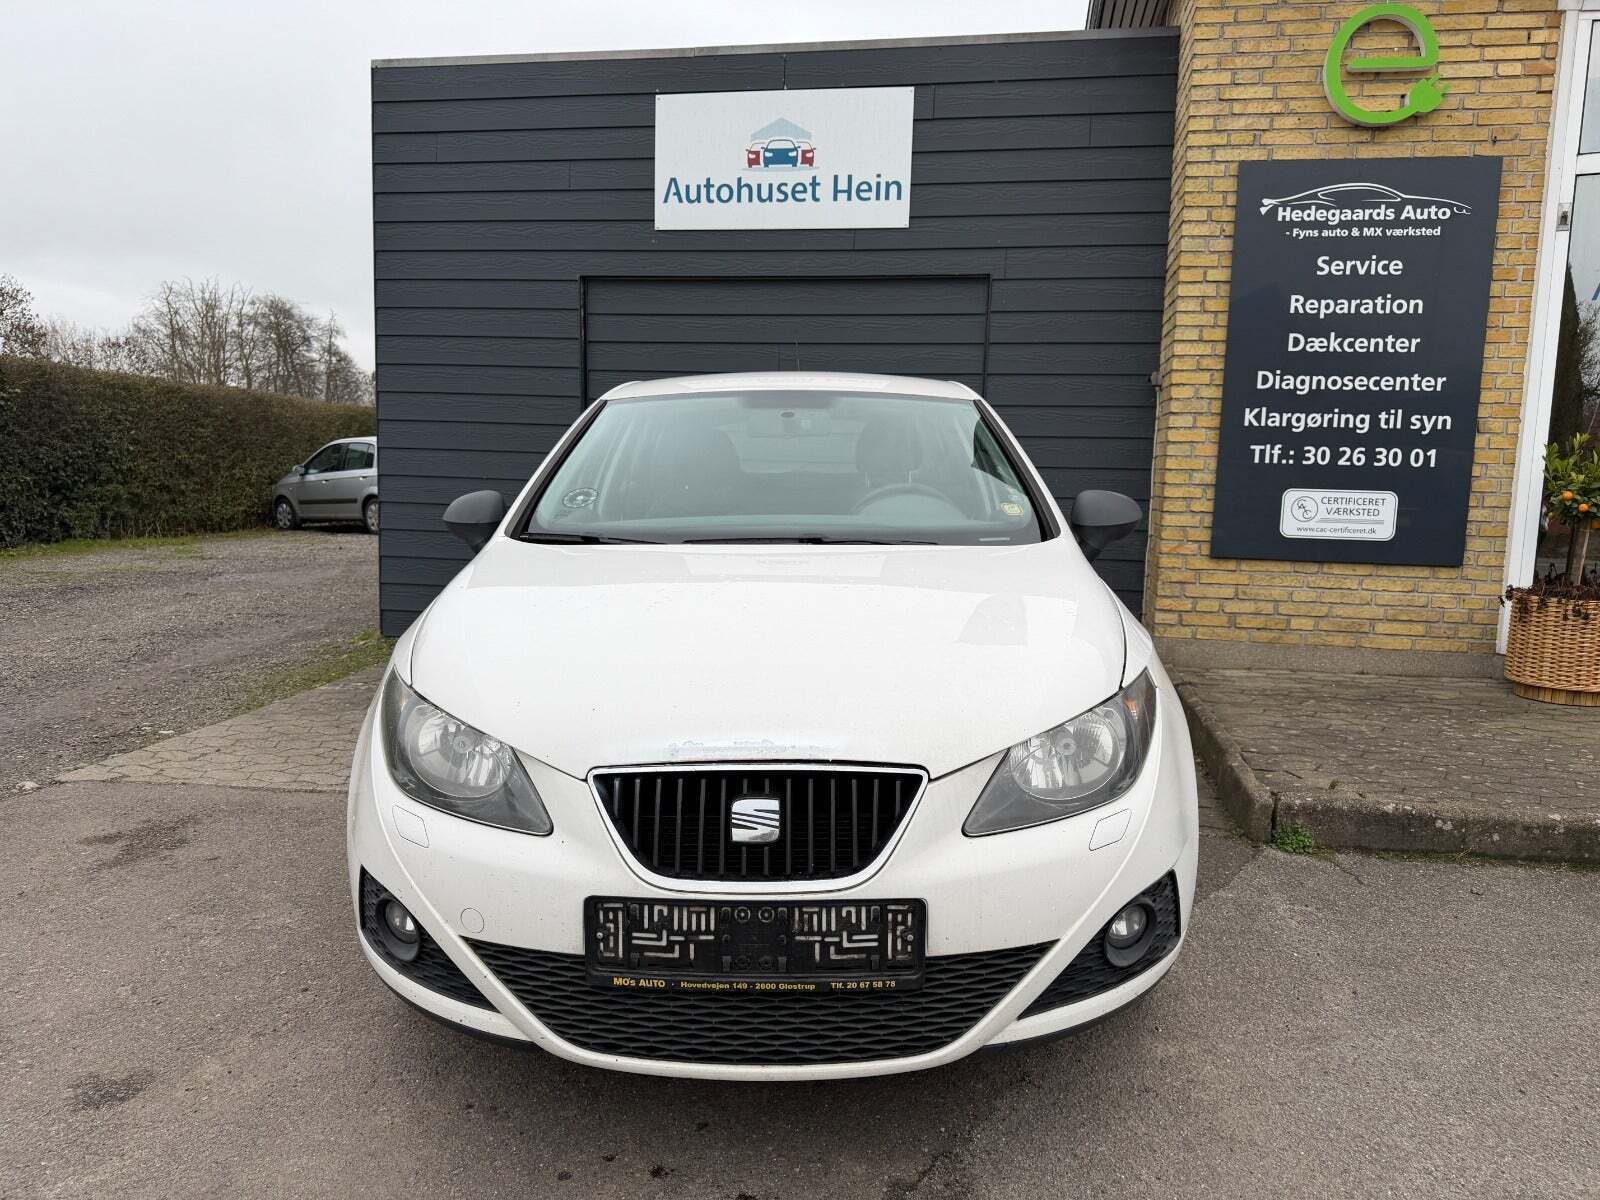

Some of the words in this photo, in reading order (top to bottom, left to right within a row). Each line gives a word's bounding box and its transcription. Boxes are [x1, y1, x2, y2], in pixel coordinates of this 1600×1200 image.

[662, 176, 822, 204] Autohuset
[832, 173, 903, 202] Hein
[1277, 205, 1395, 225] Hedegaards
[1400, 205, 1451, 220] Auto
[1292, 228, 1319, 240] Fyns
[1321, 227, 1349, 237] auto
[1351, 227, 1360, 237] &
[1363, 227, 1382, 237] MX
[1385, 226, 1441, 237] værksted
[1316, 255, 1403, 276] Service
[1289, 294, 1423, 319] Reparation
[1287, 332, 1420, 353] Dækcenter
[1256, 370, 1447, 395] Diagnosecenter
[1243, 407, 1371, 434] Klargøring
[1378, 409, 1402, 430] til
[1410, 415, 1451, 434] syn
[1250, 445, 1295, 465] Tlf.:
[1302, 446, 1331, 466] 30
[1337, 447, 1366, 467] 26
[1373, 448, 1402, 468] 30
[1409, 448, 1438, 468] 01
[1321, 496, 1386, 507] CERTIFICERET
[1326, 507, 1380, 517] VÆRKSTED
[1296, 526, 1377, 535] www.cac-certificeret.dk
[639, 979, 666, 988] AUTO
[778, 983, 816, 991] Glostrup
